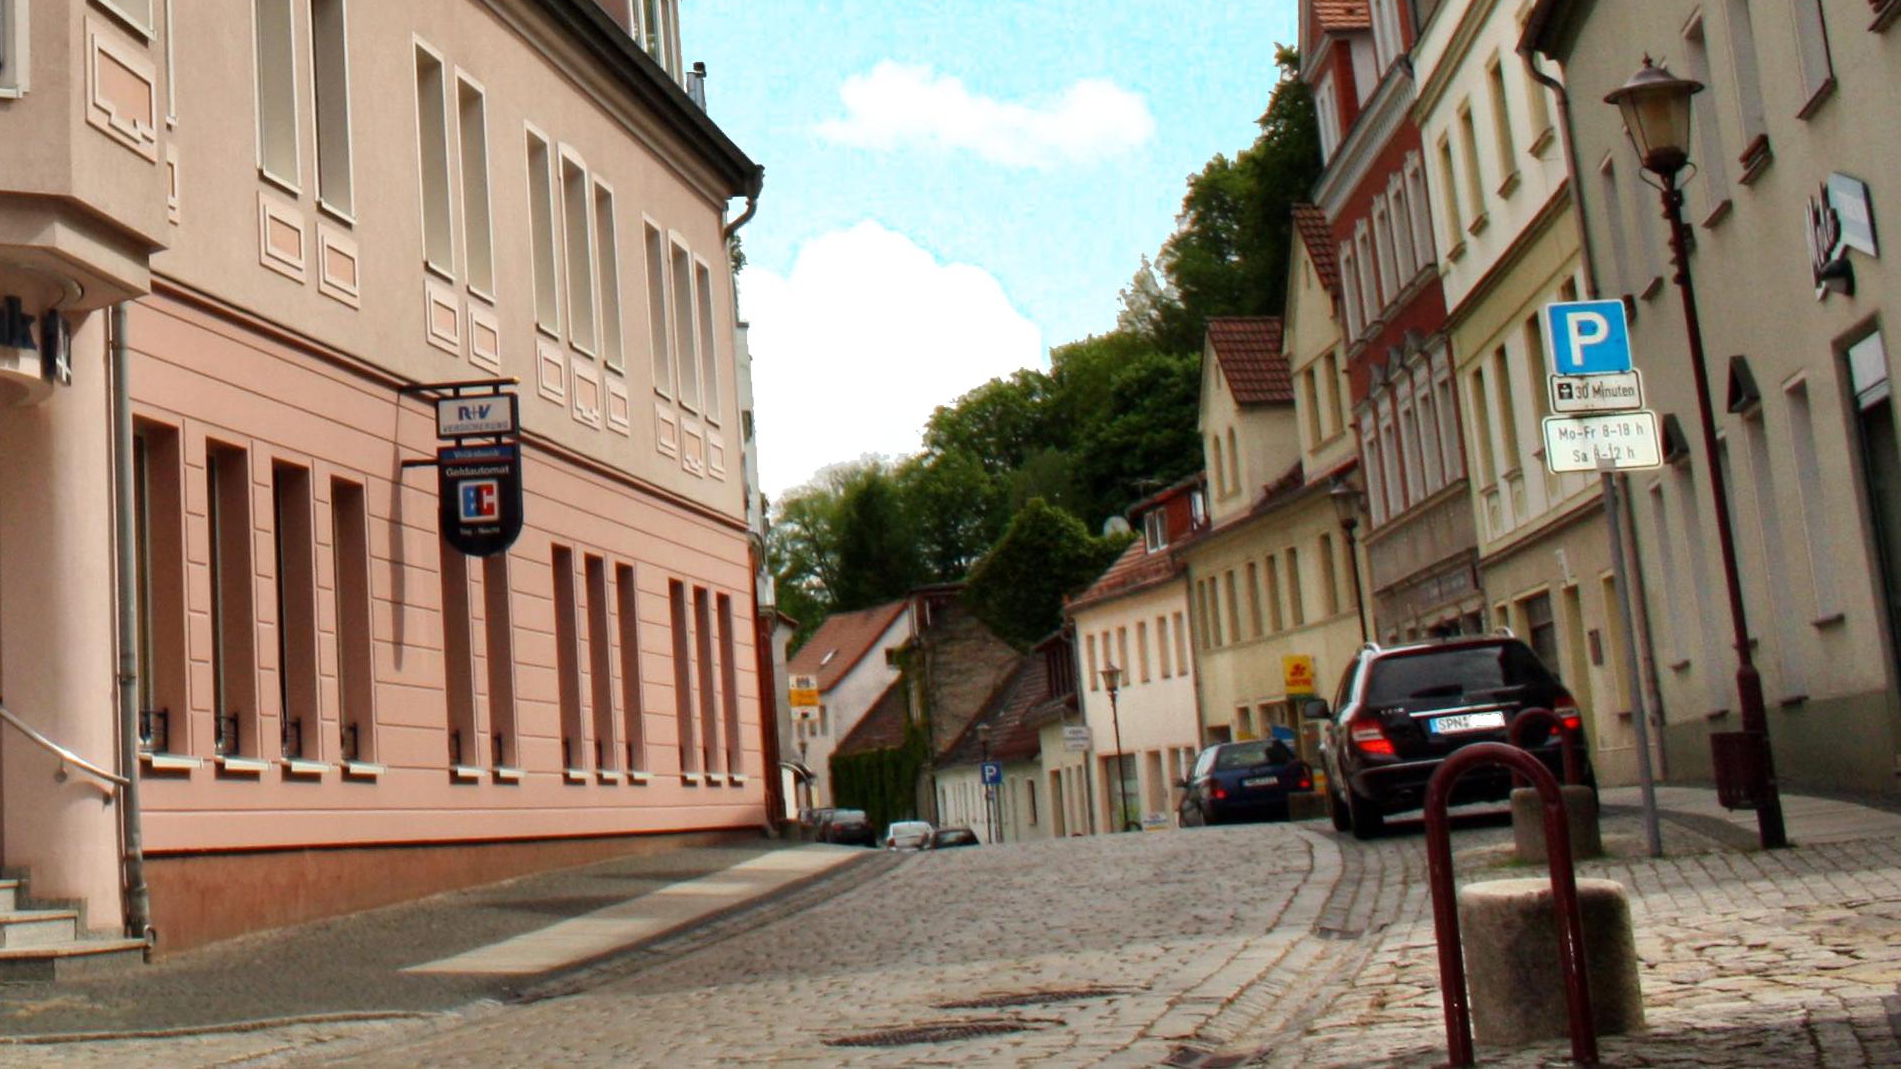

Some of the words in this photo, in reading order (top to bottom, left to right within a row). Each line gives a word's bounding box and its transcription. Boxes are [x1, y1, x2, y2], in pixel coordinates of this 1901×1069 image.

[1566, 311, 1609, 367] P
[1575, 383, 1589, 400] 30
[1592, 383, 1635, 399] Minuten
[457, 404, 492, 421] R+V
[1558, 425, 1596, 441] Mo-Fr
[1602, 423, 1630, 438] 8-18
[1636, 422, 1644, 435] h
[453, 448, 500, 460] Volksbank
[1572, 449, 1588, 463] Sa
[1594, 444, 1621, 461] 8-12
[1627, 446, 1635, 459] h
[445, 464, 509, 477] Geldautomat
[984, 765, 997, 782] P
